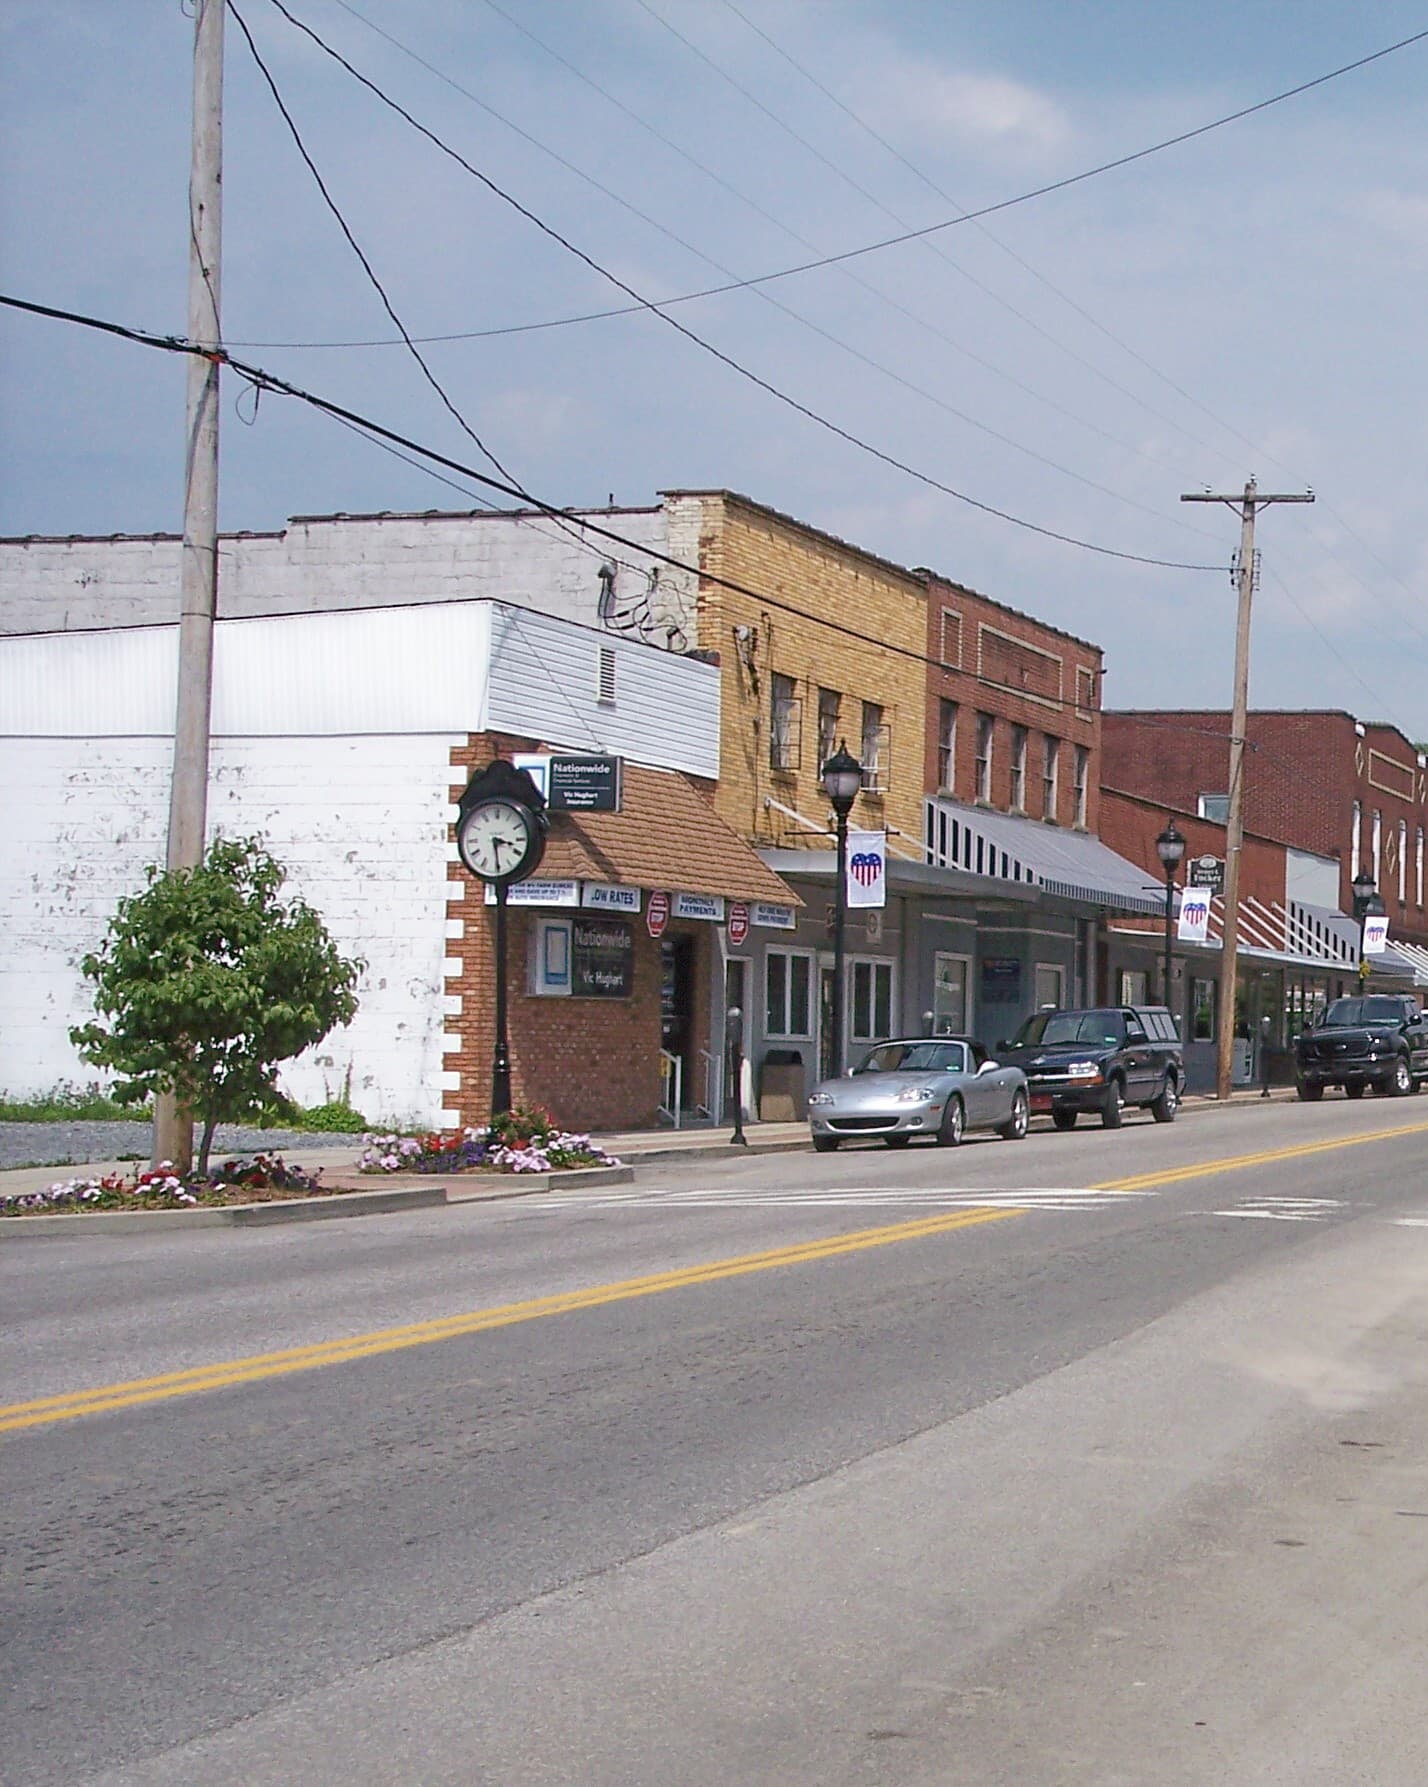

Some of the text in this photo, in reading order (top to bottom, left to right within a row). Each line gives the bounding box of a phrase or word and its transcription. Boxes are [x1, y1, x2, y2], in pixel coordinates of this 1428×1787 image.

[553, 763, 611, 774] Nationwide
[609, 889, 634, 905] RATES
[679, 904, 717, 916] PAYMENTS
[574, 926, 631, 948] Nationwide
[582, 970, 594, 984] Vic
